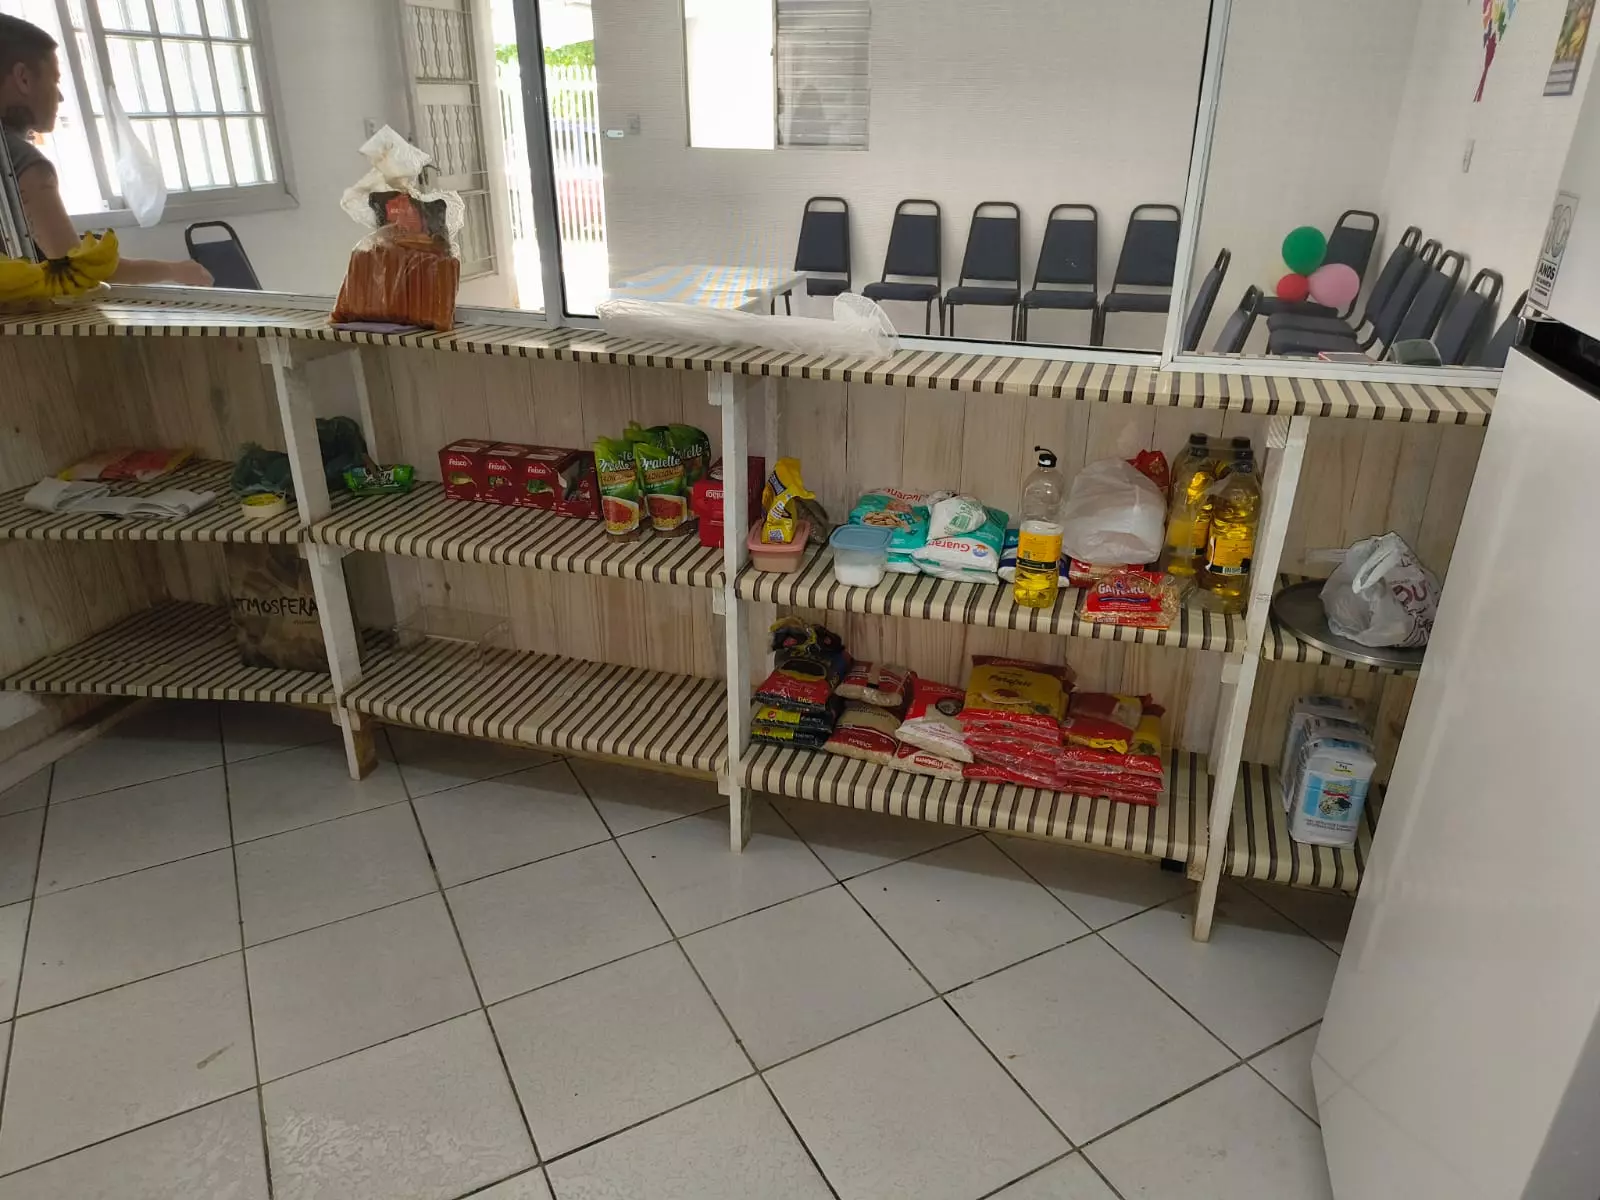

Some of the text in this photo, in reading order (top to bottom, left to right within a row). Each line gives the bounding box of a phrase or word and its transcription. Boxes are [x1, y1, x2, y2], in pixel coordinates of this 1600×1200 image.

[1539, 262, 1556, 281] ANOS
[449, 458, 467, 467] Frisco
[488, 462, 507, 471] Frisco
[527, 465, 546, 474] Frisco
[927, 540, 970, 552] Guaran
